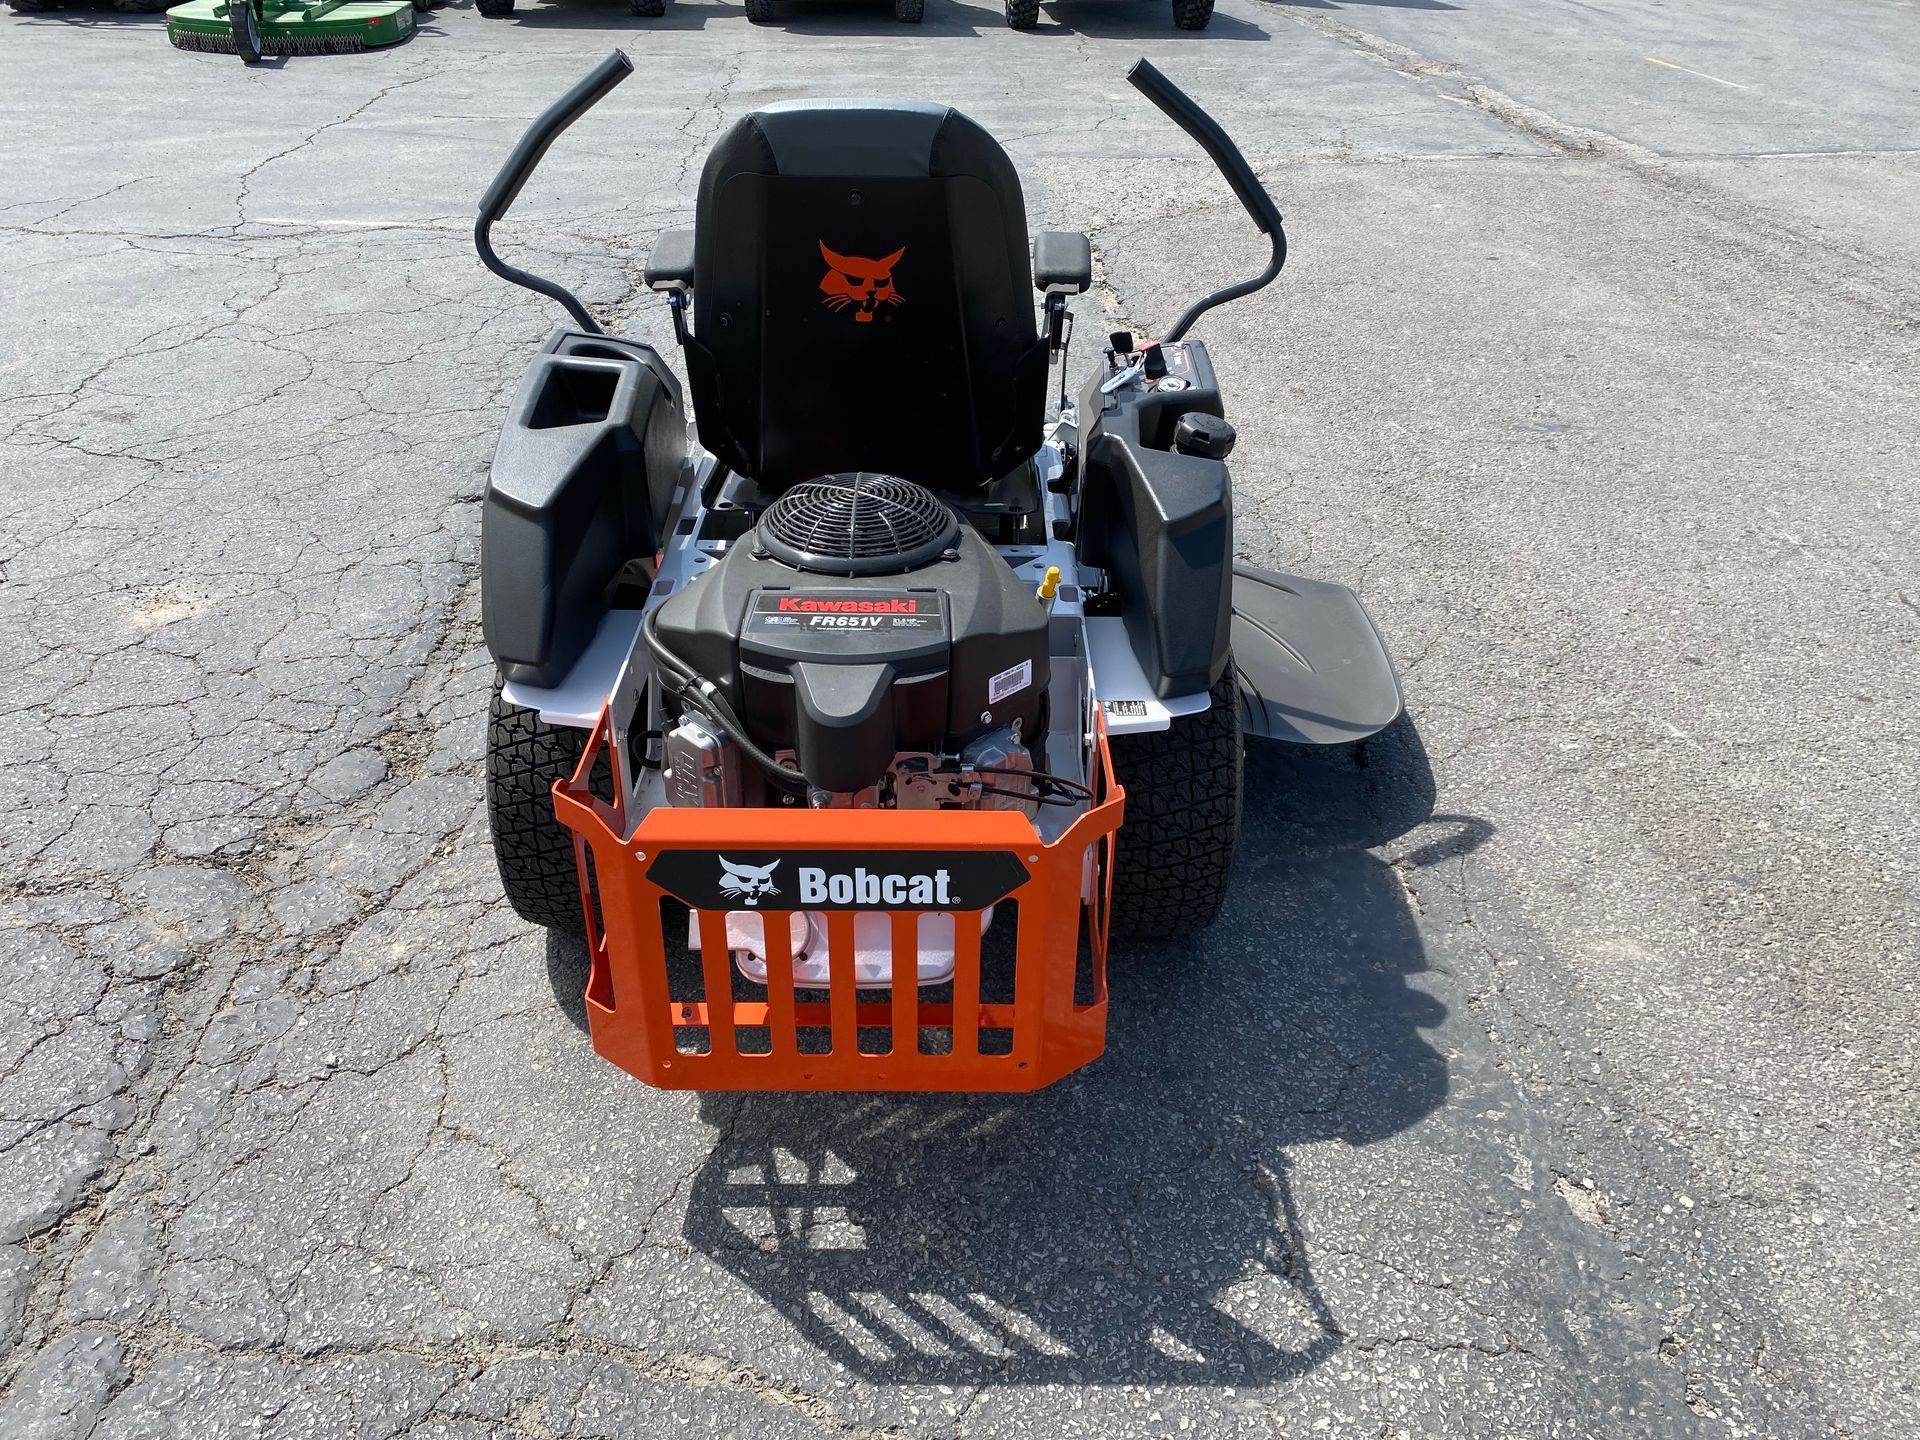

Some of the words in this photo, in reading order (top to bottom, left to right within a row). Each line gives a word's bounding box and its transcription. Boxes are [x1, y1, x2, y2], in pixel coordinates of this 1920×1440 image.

[779, 597, 917, 613] Kawasaki
[809, 616, 883, 627] FR651V
[798, 867, 951, 905] Bobcat
